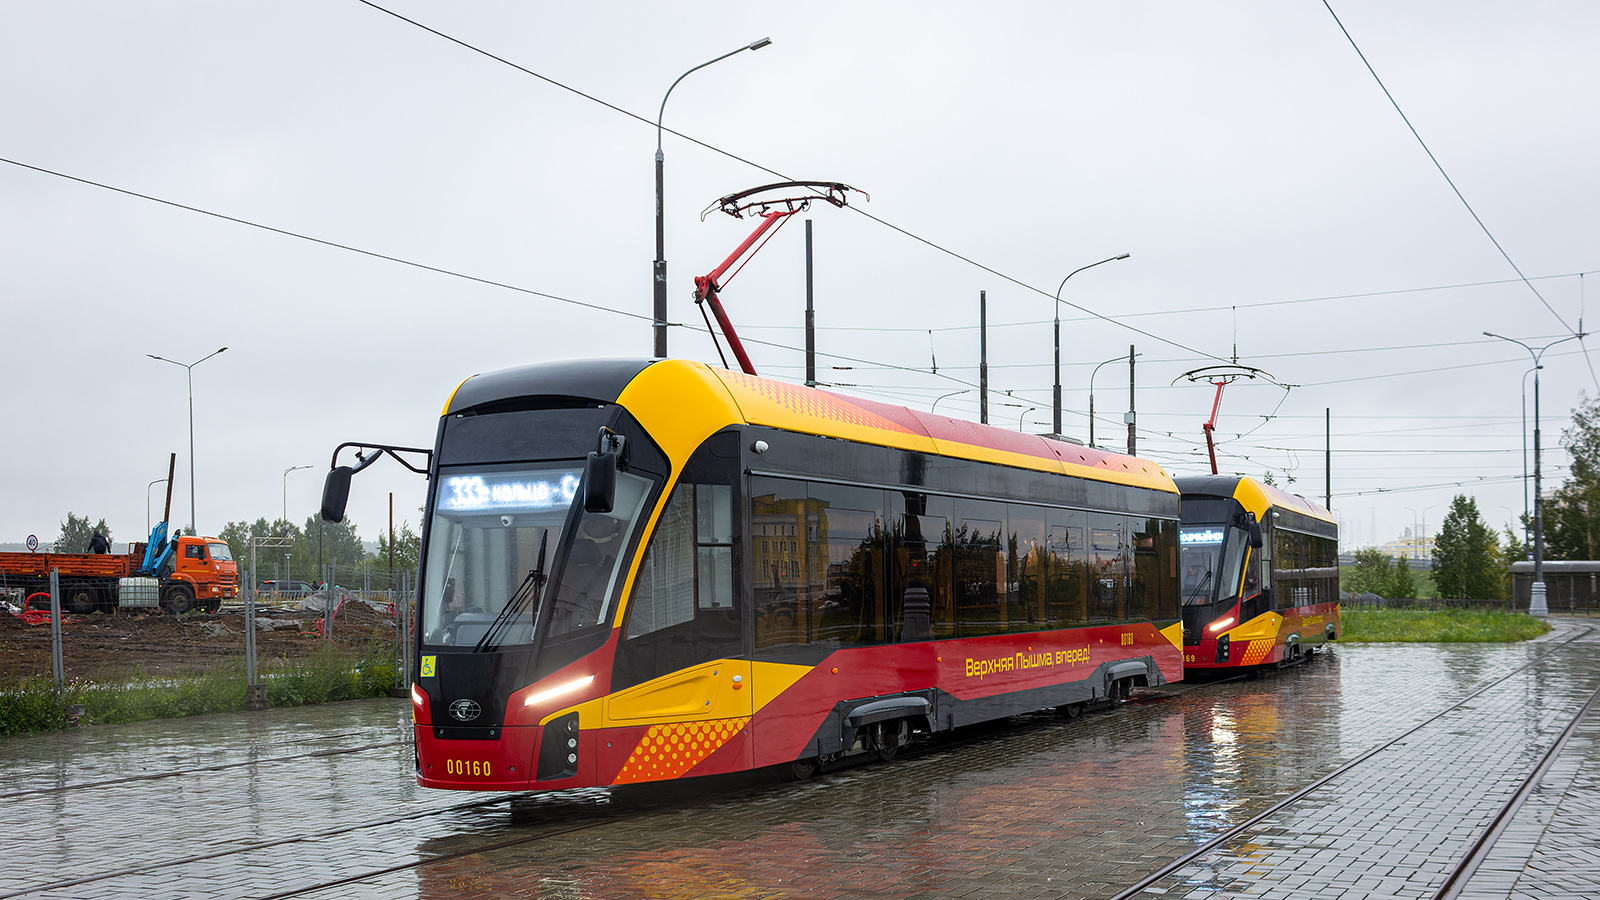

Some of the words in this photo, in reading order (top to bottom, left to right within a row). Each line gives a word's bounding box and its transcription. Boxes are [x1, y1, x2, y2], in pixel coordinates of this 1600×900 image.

[965, 658, 1014, 680] Верхняя
[1016, 652, 1054, 669] Пышма,
[1055, 644, 1090, 667] вперед!
[447, 759, 491, 776] 00160
